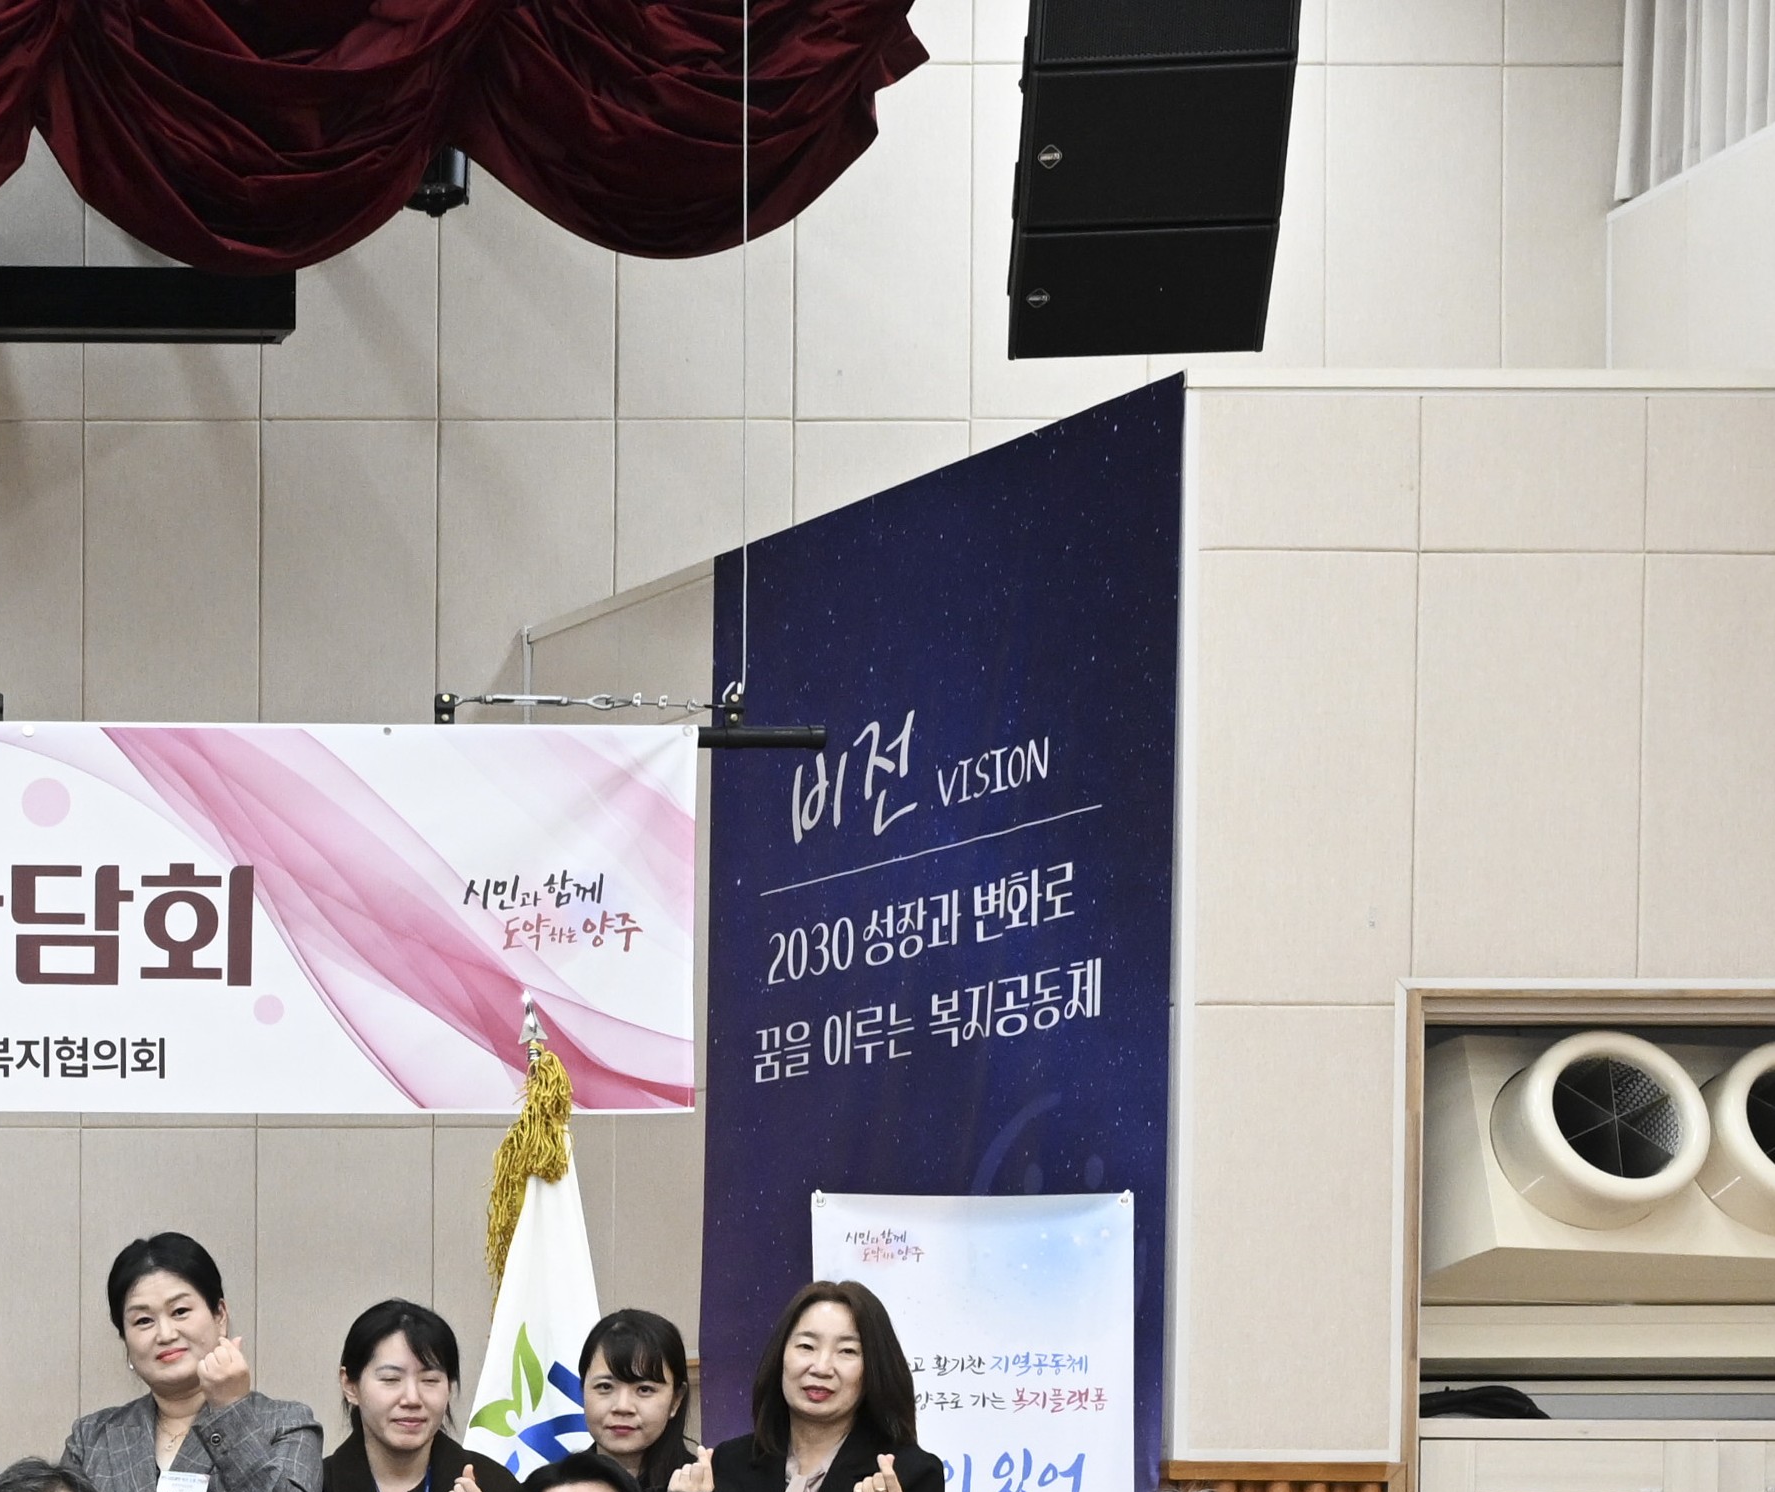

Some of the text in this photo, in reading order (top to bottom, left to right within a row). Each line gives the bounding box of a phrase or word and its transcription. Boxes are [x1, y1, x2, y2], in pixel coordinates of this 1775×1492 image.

[793, 710, 917, 843] 비전
[938, 737, 1048, 806] VISION
[463, 869, 604, 910] 시민과 함께
[502, 910, 643, 952] 도약하는 양주
[769, 862, 1074, 984] 2030 성장과 변화로
[754, 958, 1101, 1082] 꿈을 이루는 복지공동체
[897, 1246, 926, 1263] 양주
[932, 1353, 986, 1377] 활기찬
[990, 1352, 1088, 1377] 지역공동체
[915, 1387, 1108, 1413] 양주로 가는 복지플랫폼
